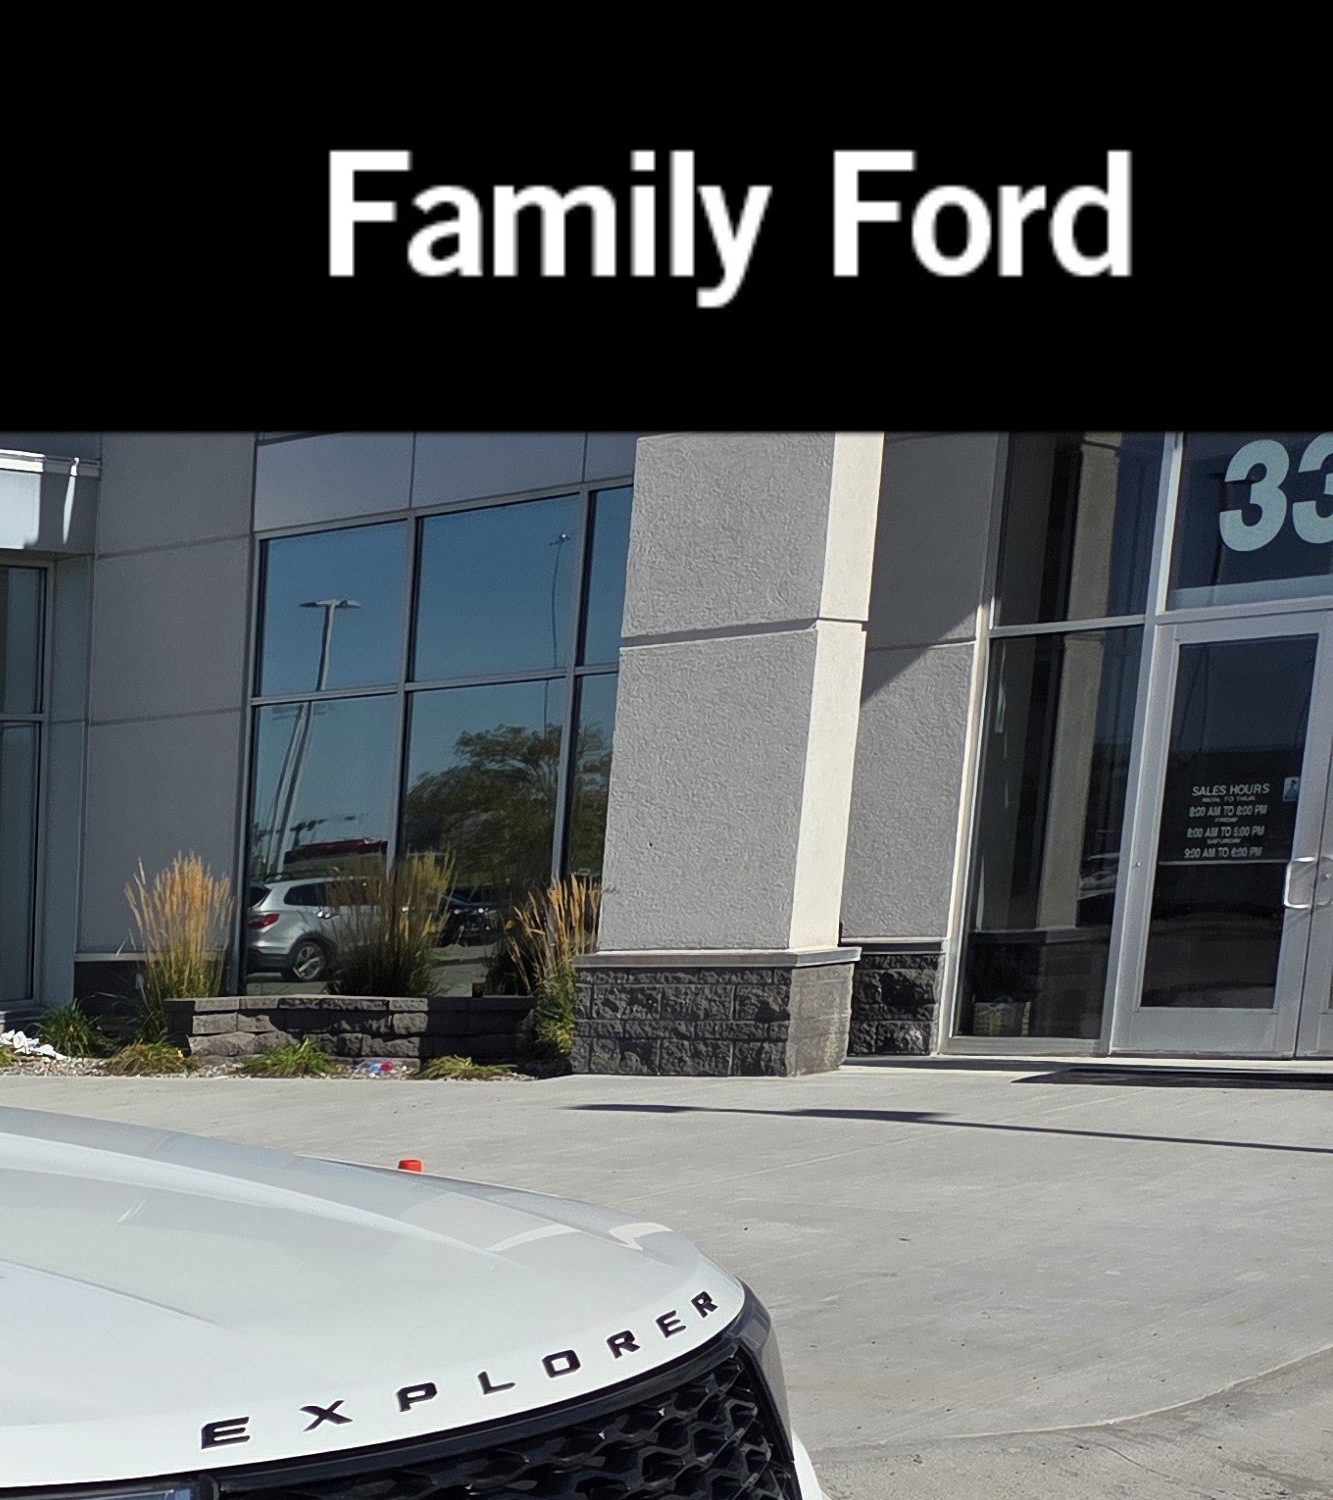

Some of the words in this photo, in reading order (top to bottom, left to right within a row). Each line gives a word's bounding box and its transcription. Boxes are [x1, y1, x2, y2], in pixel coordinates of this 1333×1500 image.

[1192, 785, 1227, 796] SALES
[1230, 783, 1270, 795] HOURS
[1207, 806, 1221, 816] AM
[1223, 805, 1234, 816] TO
[1254, 804, 1268, 815] PM
[1205, 827, 1218, 837] AM
[1221, 826, 1231, 837] TO
[1252, 825, 1265, 836] PM
[1202, 847, 1216, 858] AM
[1218, 846, 1229, 857] TO
[1249, 846, 1263, 857] PM
[200, 1290, 719, 1450] EXPLORER
